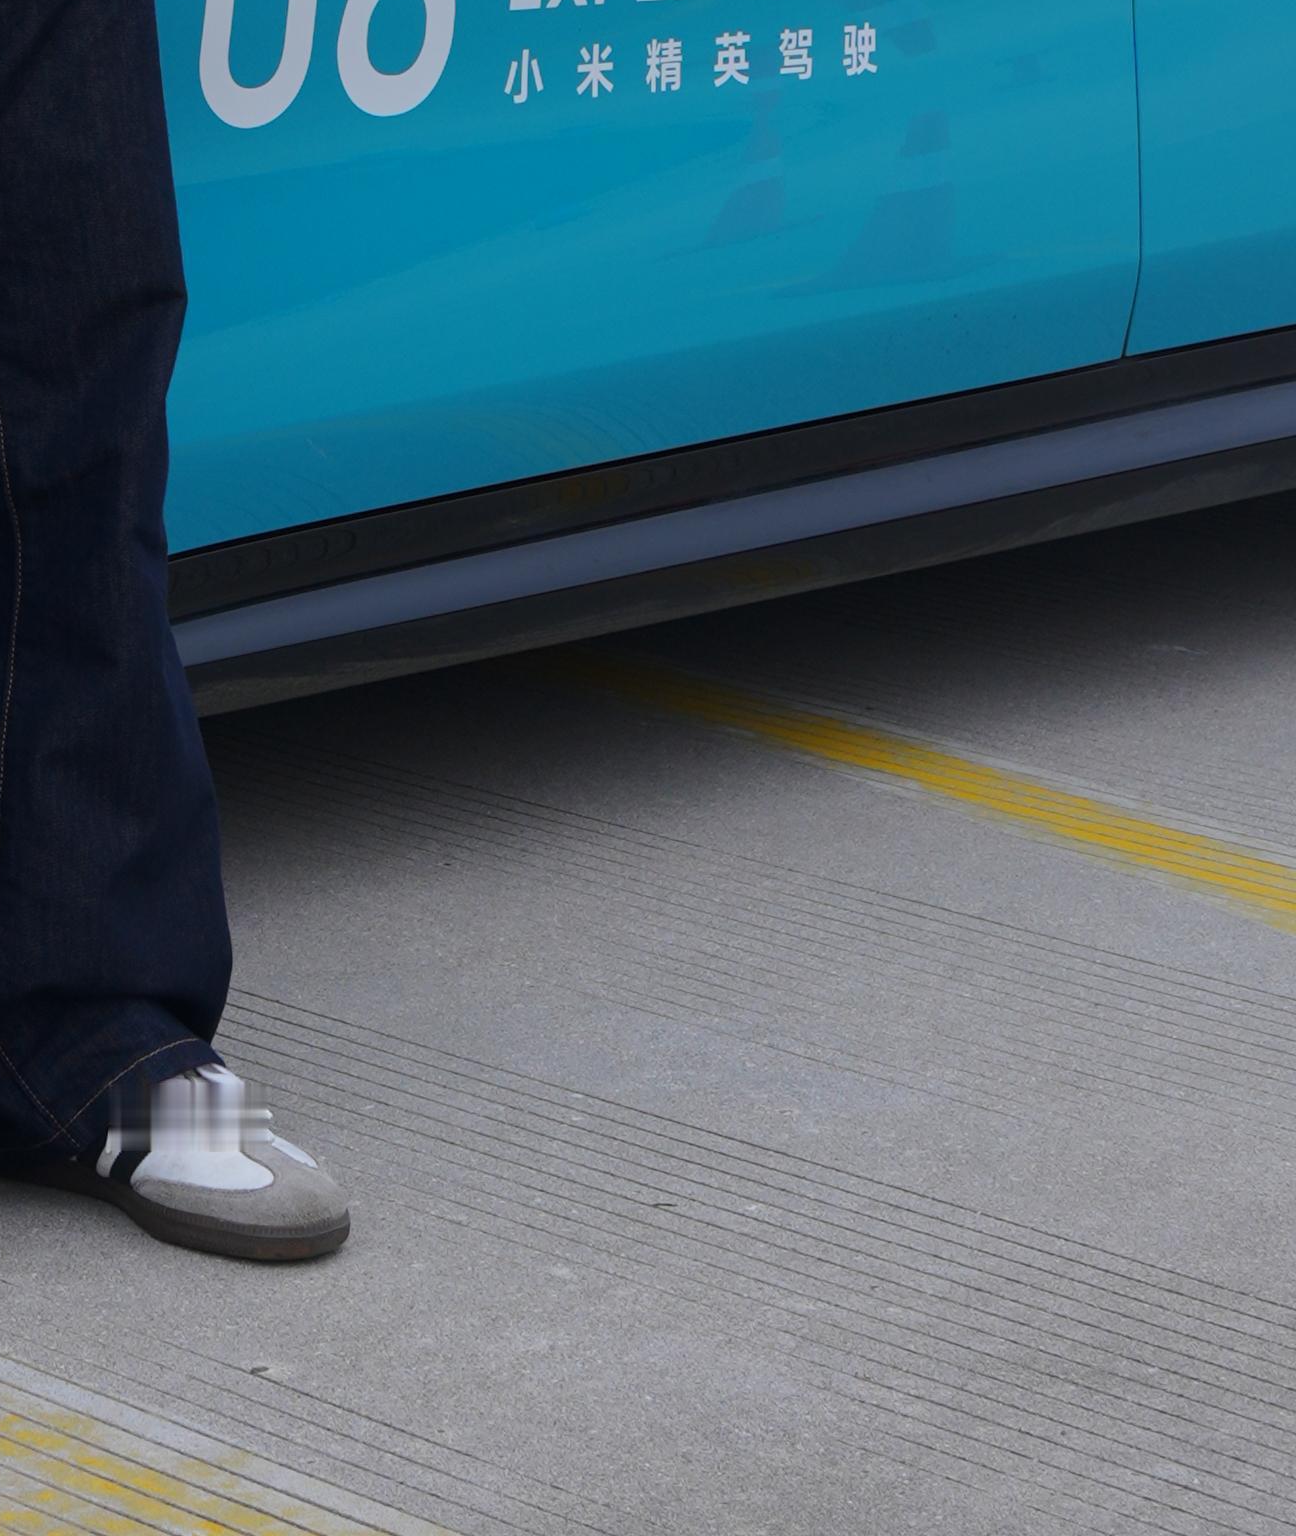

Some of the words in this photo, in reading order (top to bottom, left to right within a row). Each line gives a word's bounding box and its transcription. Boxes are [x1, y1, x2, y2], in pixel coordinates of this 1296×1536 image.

[504, 21, 878, 105] 小米精英驾驶
